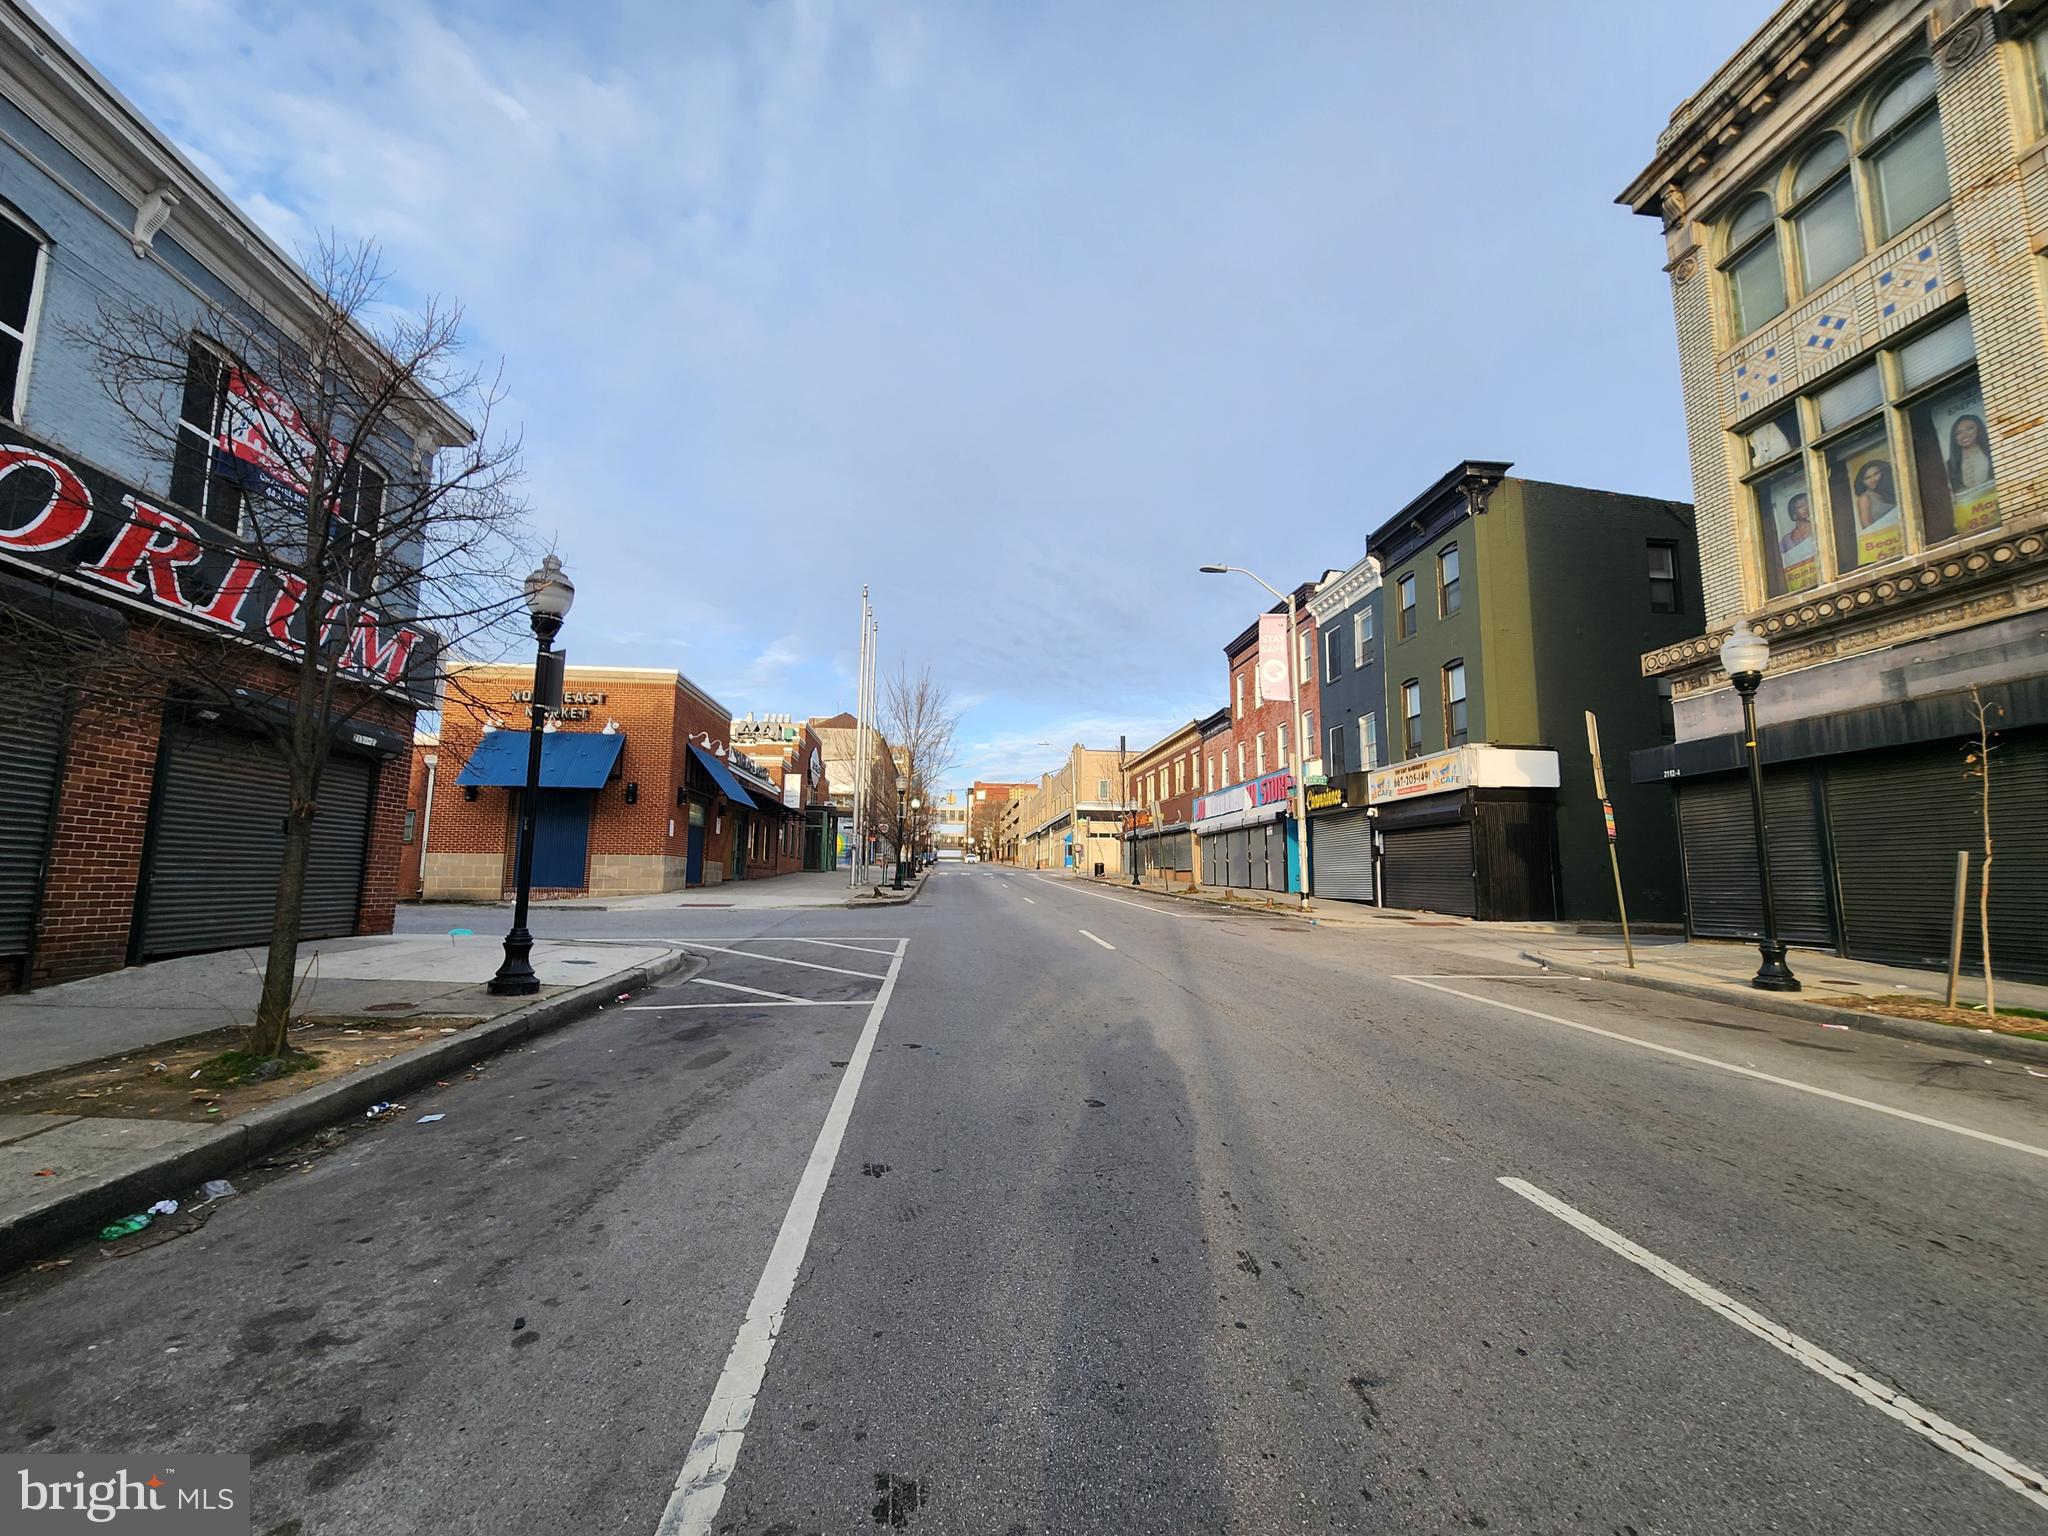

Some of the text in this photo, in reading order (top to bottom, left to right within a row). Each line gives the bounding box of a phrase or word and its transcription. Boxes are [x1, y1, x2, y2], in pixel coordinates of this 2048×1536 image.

[1260, 633, 1286, 643] STAY
[525, 705, 589, 719] MRKET
[1440, 776, 1460, 785] CAFE
[1377, 789, 1393, 798] CAFE
